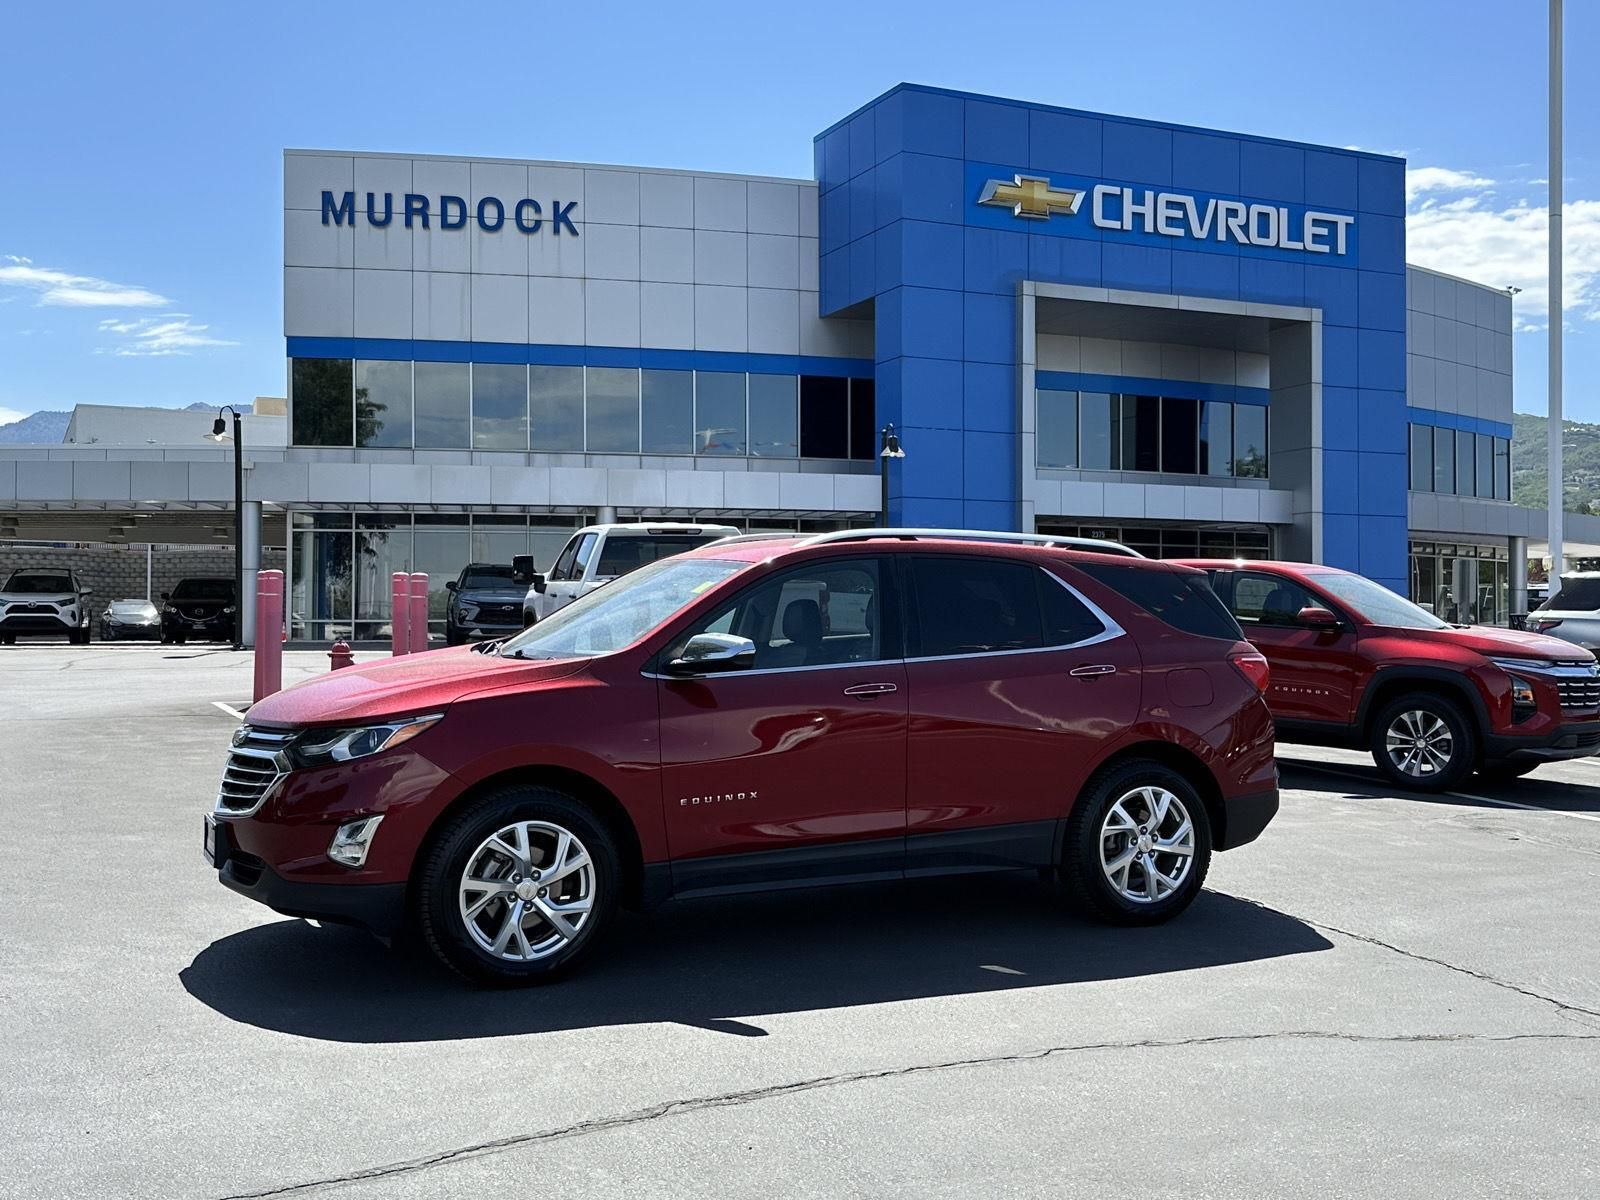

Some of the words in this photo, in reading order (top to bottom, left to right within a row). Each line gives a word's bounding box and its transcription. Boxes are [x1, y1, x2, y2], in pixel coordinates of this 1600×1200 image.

[321, 190, 579, 237] MURDOCK
[1093, 184, 1355, 255] CHEVROLET
[680, 791, 758, 806] EQUINOX
